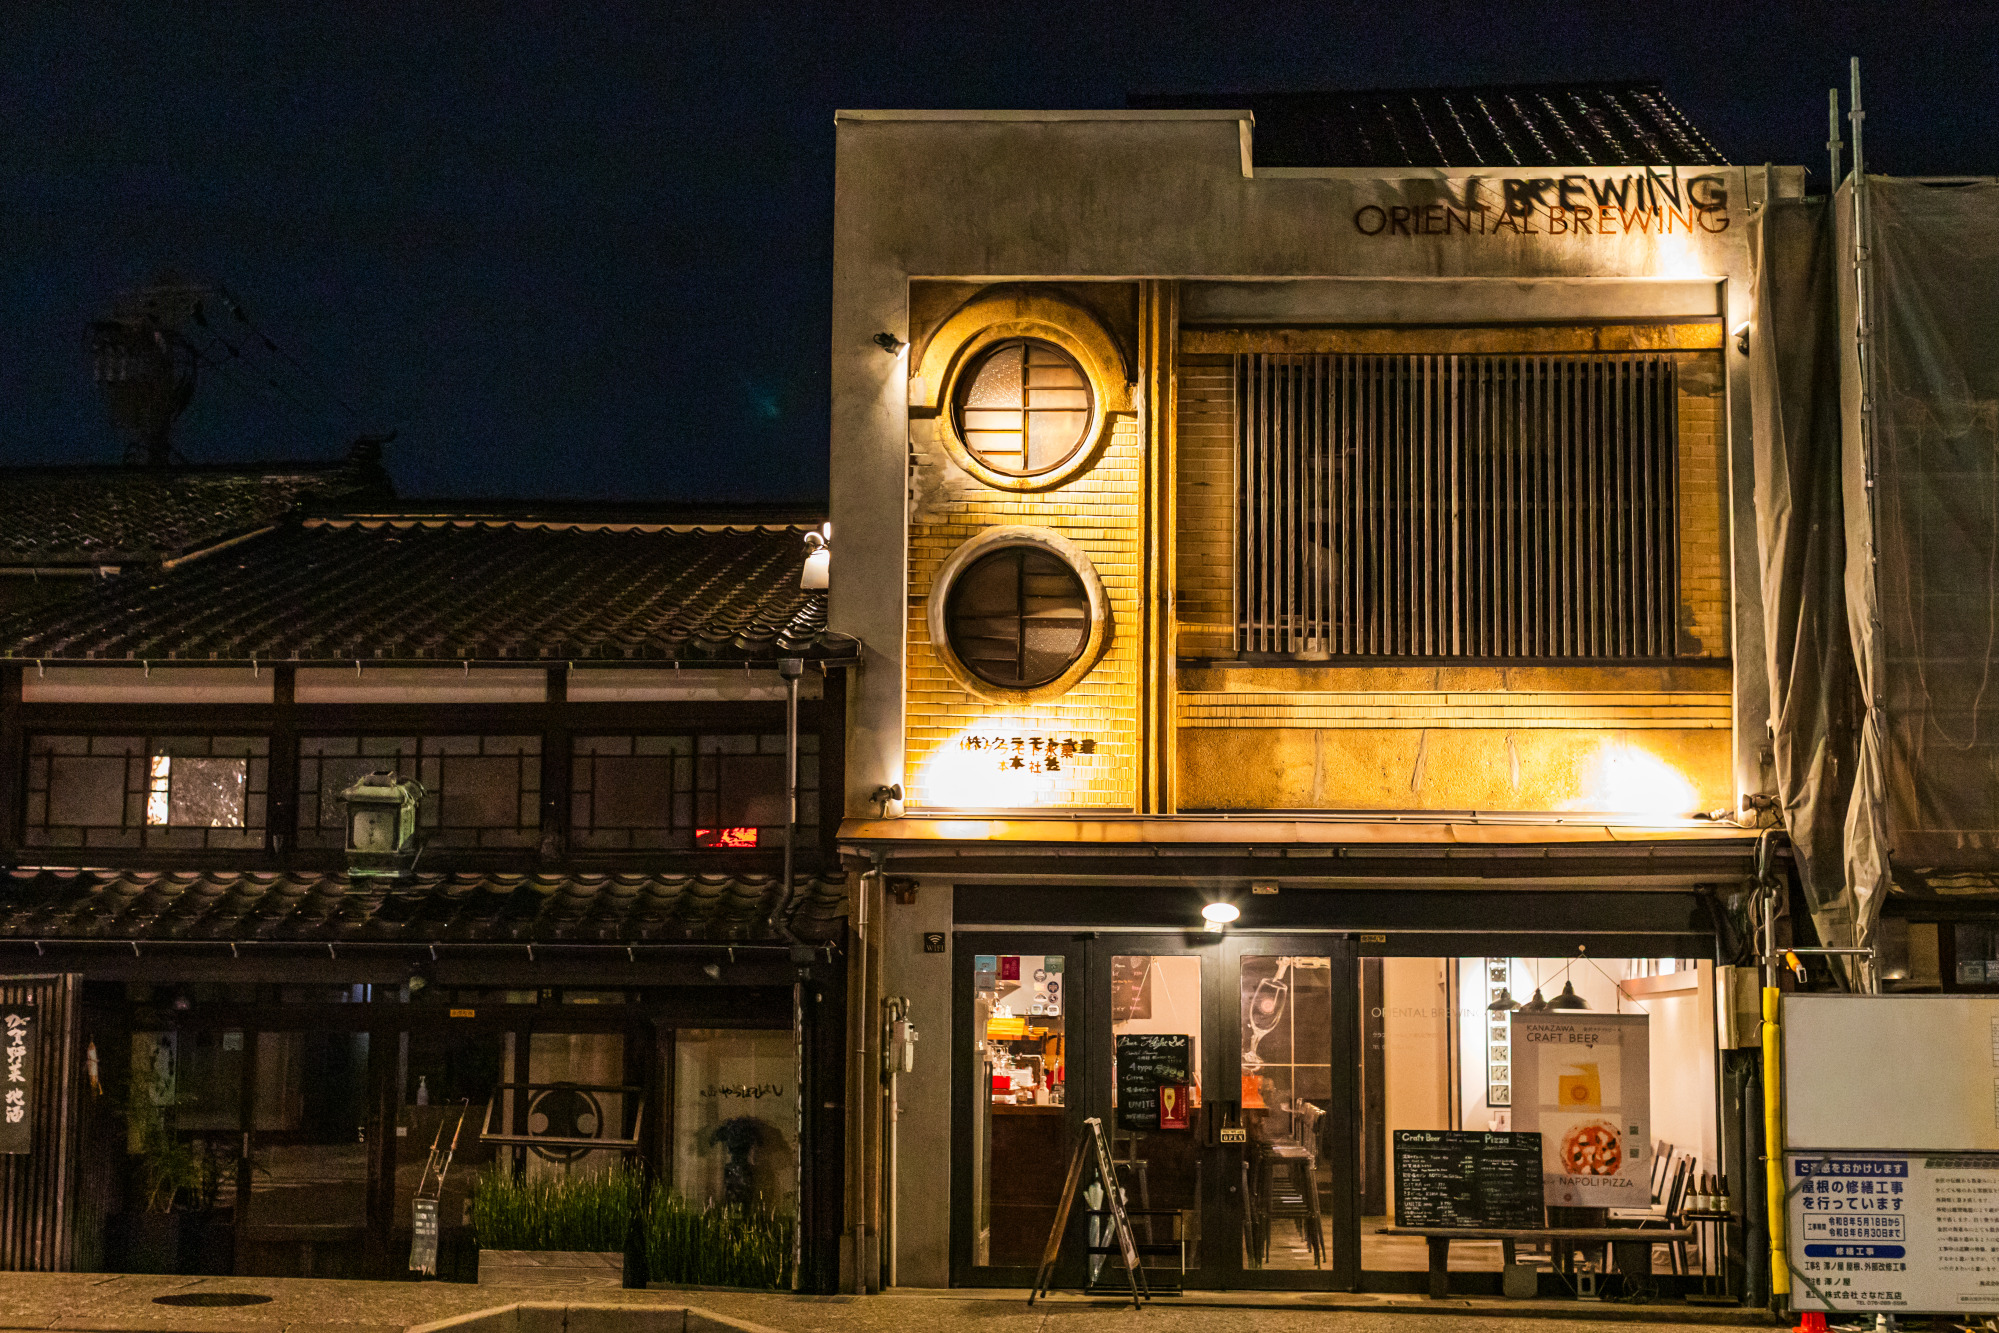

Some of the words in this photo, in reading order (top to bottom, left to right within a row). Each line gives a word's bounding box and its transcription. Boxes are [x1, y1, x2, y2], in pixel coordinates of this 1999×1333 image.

[1354, 204, 1540, 235] ORIENTAL
[1548, 204, 1731, 235] BREWING
[1526, 1024, 1575, 1032] KANAZAWA
[1526, 1032, 1563, 1043] CRAFT
[1569, 1033, 1599, 1043] BEER
[1137, 1065, 1153, 1073] type
[5, 1088, 25, 1123] 地酒
[1128, 1099, 1156, 1109] UNITE
[1401, 1132, 1424, 1142] Craft
[1425, 1132, 1441, 1142] Beer
[1484, 1133, 1510, 1144] Pizza
[1559, 1177, 1600, 1187] NAPOLI
[1602, 1178, 1634, 1188] PIZZA
[1801, 1180, 1904, 1195] 屋根の修繕工事
[1802, 1196, 1904, 1211] を行っています
[1828, 1216, 1900, 1227] 令和8年5月18日から
[1829, 1227, 1901, 1238] 令和8年6月30日まで
[1835, 1247, 1874, 1256] 修繕工事
[1825, 1290, 1858, 1300] 株式会社
[1860, 1291, 1903, 1300] さなだ瓦店
